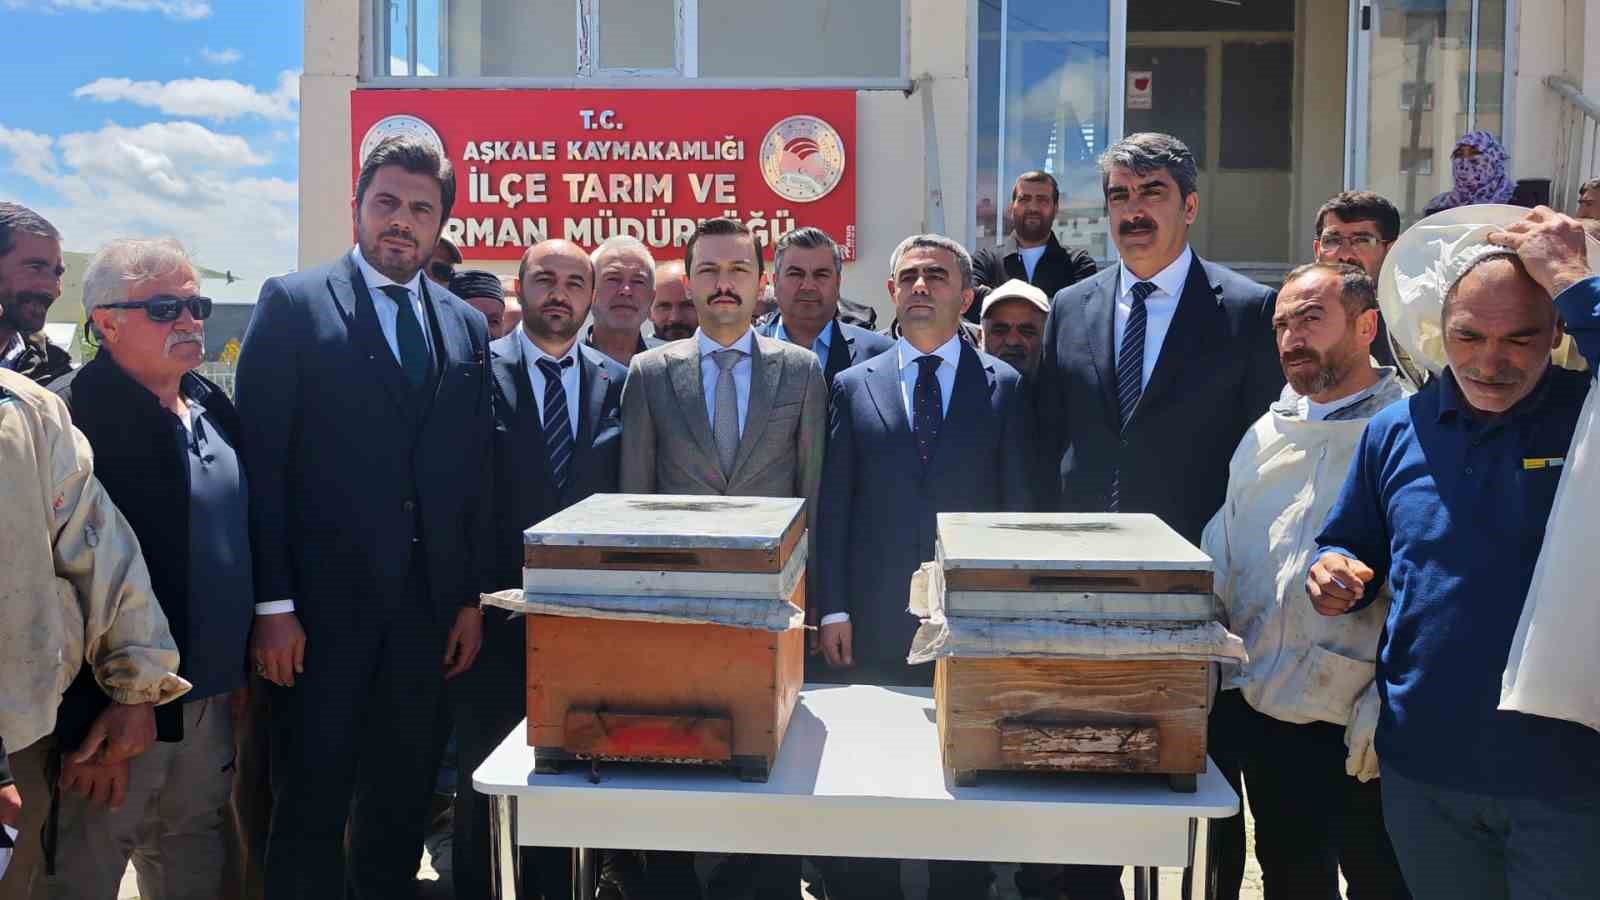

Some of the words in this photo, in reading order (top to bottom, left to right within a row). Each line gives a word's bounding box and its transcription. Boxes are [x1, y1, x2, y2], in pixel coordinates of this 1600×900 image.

[579, 110, 624, 130] T.C.
[463, 141, 556, 163] AŞKALE
[567, 136, 745, 161] KAYMAKAMLIĞI
[468, 166, 547, 208] İLÇE
[562, 173, 672, 204] TARIM
[688, 173, 736, 204] VE
[444, 217, 547, 247] RMAN
[563, 209, 795, 247] MÜDÜRĞÜ
